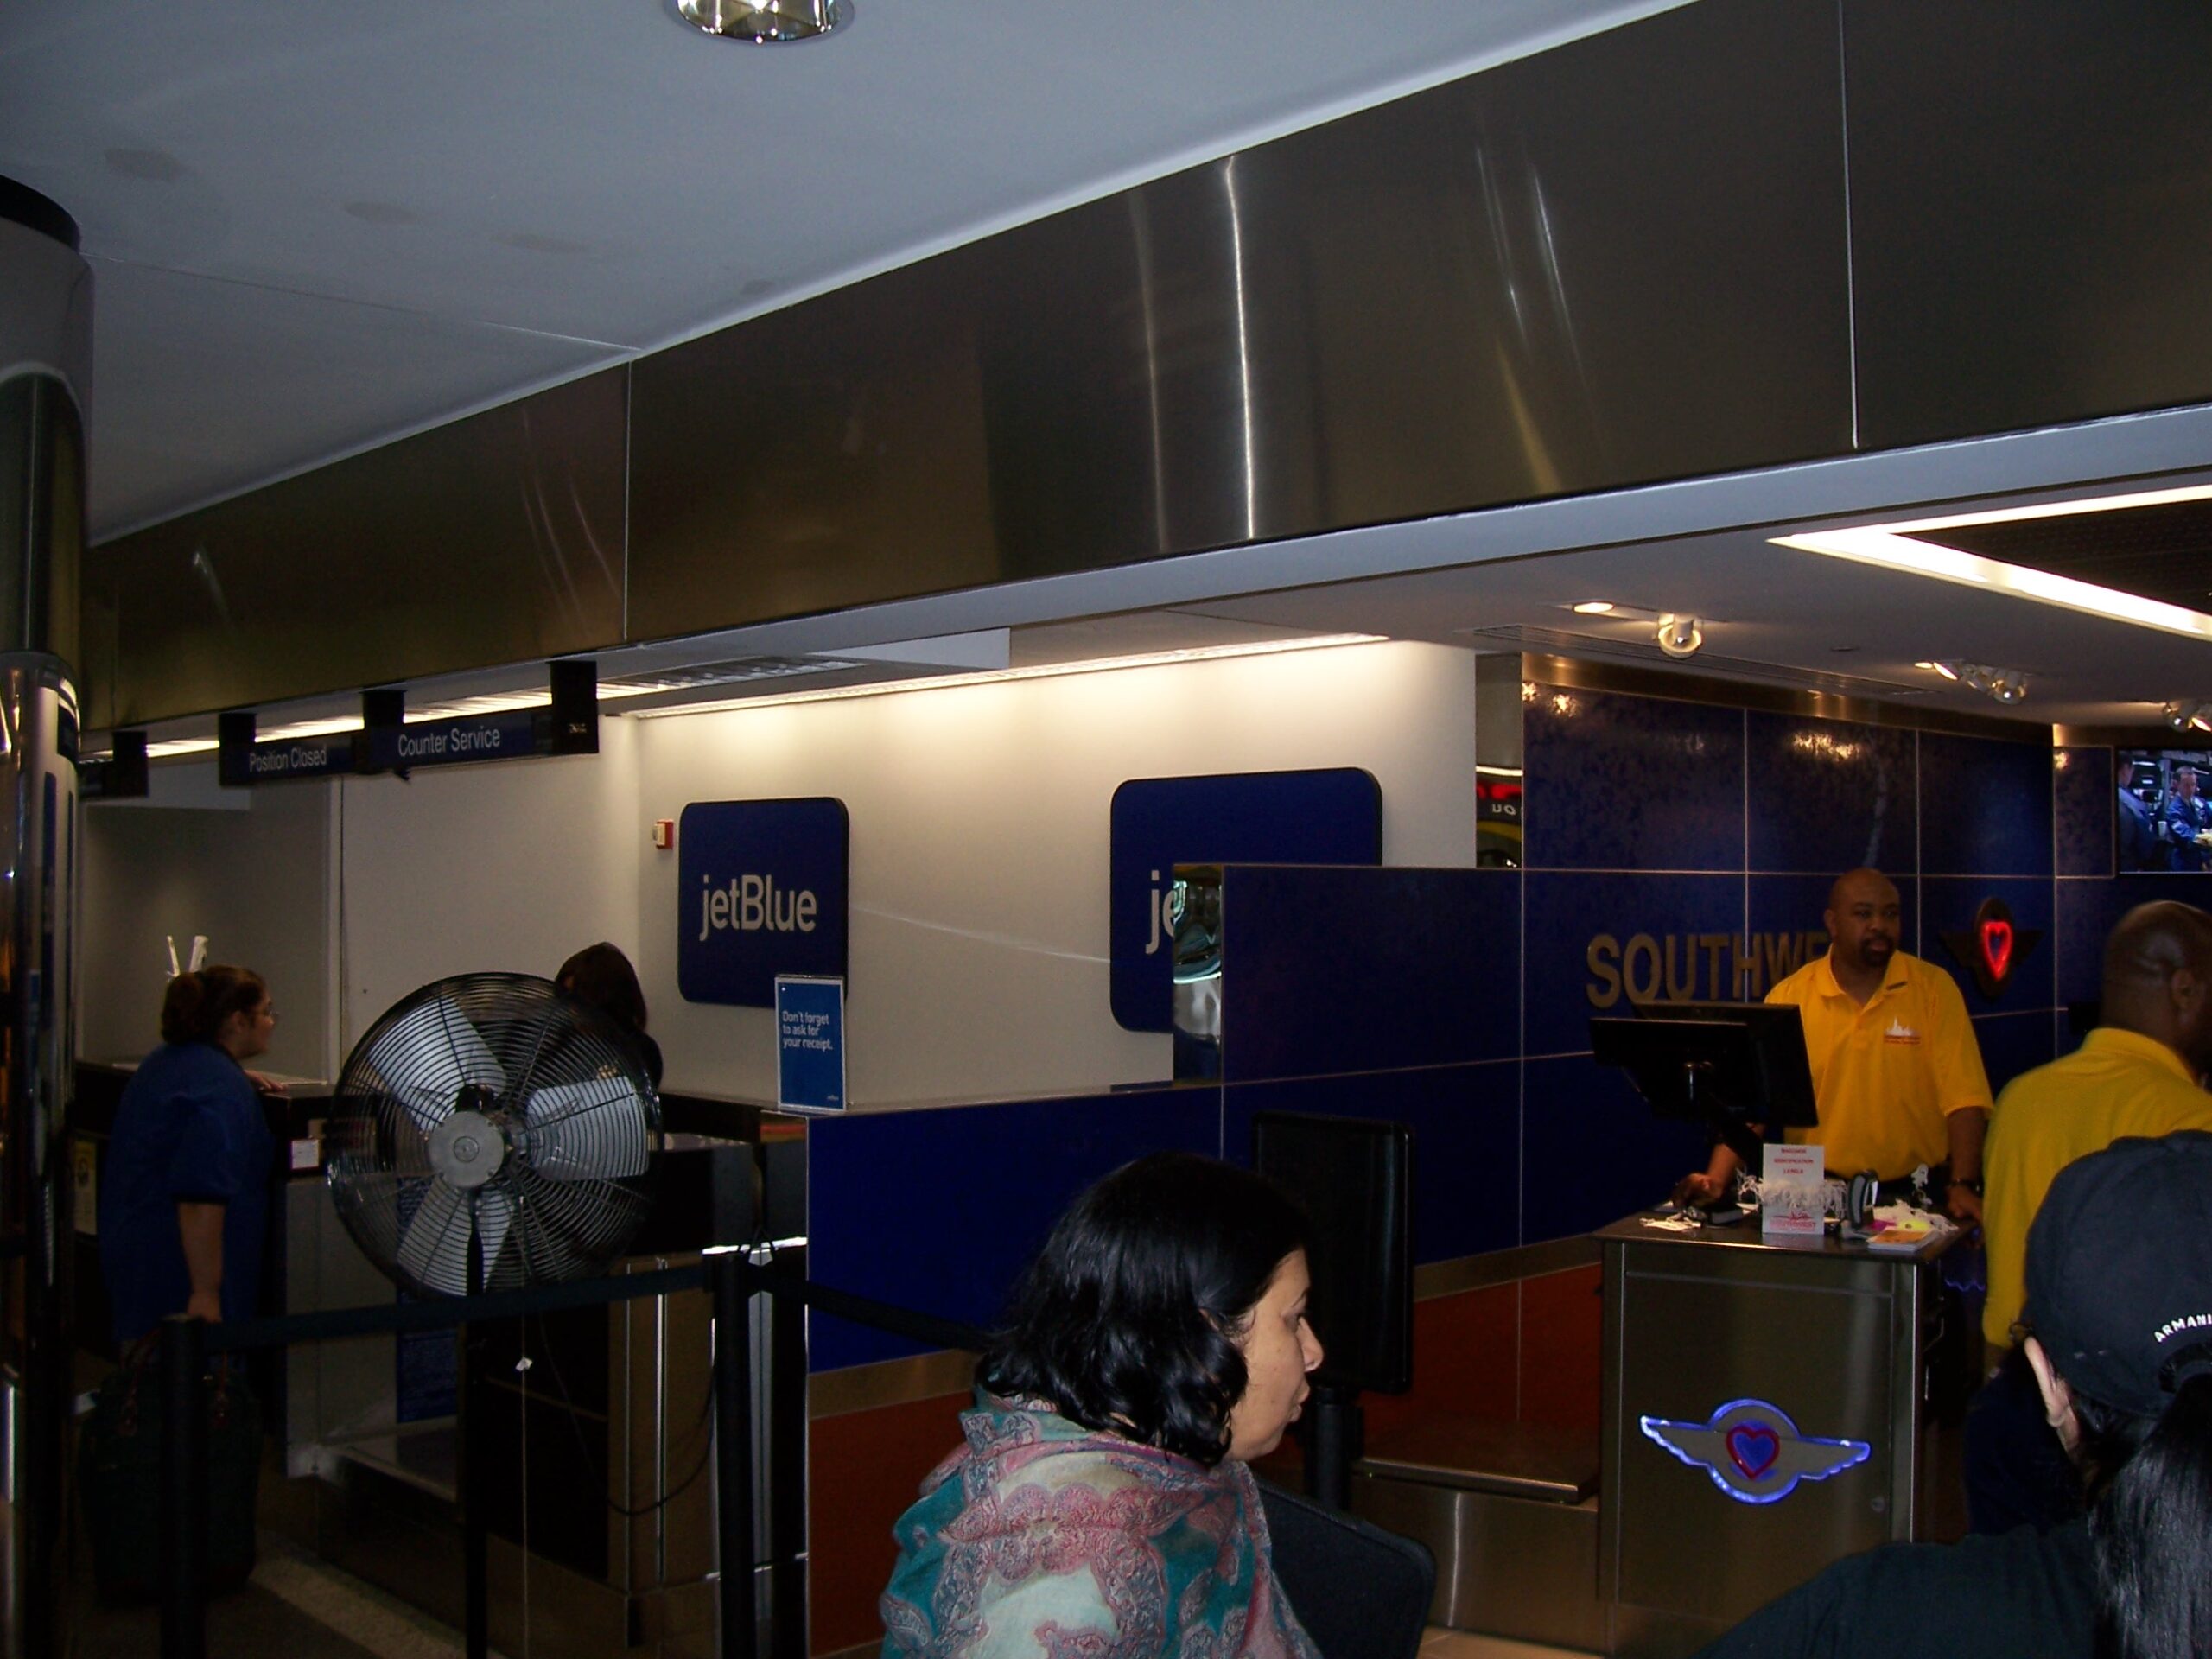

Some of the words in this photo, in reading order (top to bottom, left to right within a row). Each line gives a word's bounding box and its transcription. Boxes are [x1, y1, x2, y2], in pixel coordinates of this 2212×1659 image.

[398, 733, 448, 757] Counter
[450, 726, 501, 752] Service
[250, 749, 289, 773] Position
[290, 744, 327, 769] Closed
[699, 874, 817, 942] jetBlue
[782, 1010, 804, 1023] Don't
[804, 1012, 830, 1027] forget
[782, 1024, 791, 1035] to
[792, 1024, 807, 1036] ask
[808, 1025, 820, 1037] for
[783, 1039, 801, 1049] your
[802, 1037, 834, 1052] receipt.
[2154, 1313, 2212, 1343] ARMANI
